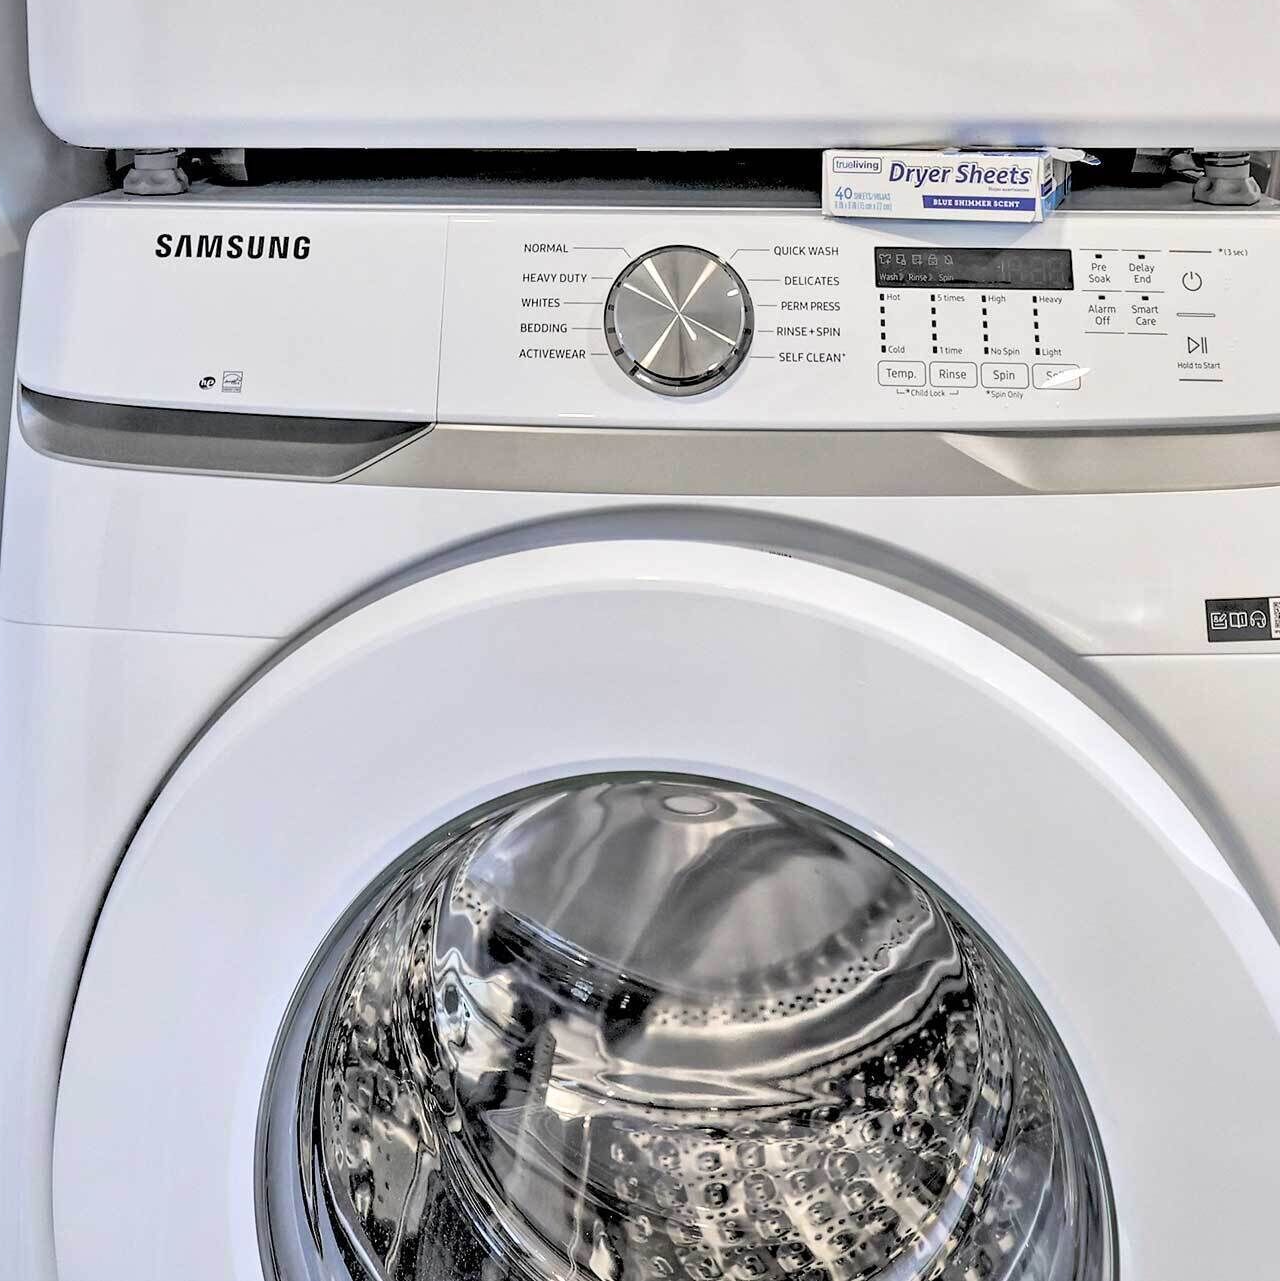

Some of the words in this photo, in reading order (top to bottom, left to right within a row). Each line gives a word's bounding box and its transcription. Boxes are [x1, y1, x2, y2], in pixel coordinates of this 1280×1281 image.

[889, 162, 950, 188] Dryer
[956, 164, 1030, 184] Sheets
[834, 186, 852, 200] 40
[933, 199, 952, 207] BLUE
[955, 199, 992, 208] SHIMMER
[994, 200, 1020, 208] SCENT
[154, 233, 311, 260] SAMSUNG
[523, 243, 569, 253] NORMAL
[773, 245, 806, 256] QUICK
[807, 246, 839, 256] WASH
[1091, 262, 1107, 272] Pre
[1128, 262, 1155, 275] Delay
[522, 273, 557, 283] HEAVY
[559, 273, 588, 283] DUTY
[784, 275, 840, 286] DELICATES
[880, 273, 898, 281] Wash
[1088, 273, 1111, 284] Soak
[1134, 274, 1151, 283] End
[886, 293, 901, 301] Hot
[936, 293, 943, 302] 5
[943, 294, 966, 302] times
[987, 295, 1006, 305] High
[1038, 295, 1063, 305] Heavy
[521, 297, 561, 308] WHITES
[781, 301, 809, 311] PERM
[810, 301, 841, 312] PRESS
[1088, 304, 1117, 314] Alarm
[1130, 304, 1159, 314] Smart
[1095, 315, 1111, 326] Off
[1135, 316, 1157, 326] Care
[520, 322, 568, 334] BEDDING
[518, 348, 586, 359] ACTIVEWEAR
[887, 345, 906, 354] Cold
[939, 346, 944, 354] 1
[944, 347, 963, 355] time
[990, 347, 1002, 356] No
[1002, 346, 1021, 357] Spin
[1041, 348, 1062, 358] Light
[778, 352, 804, 363] SELF
[1177, 361, 1194, 370] Hold
[1194, 362, 1203, 370] to
[1202, 361, 1221, 370] Start
[885, 367, 917, 380] Temp.
[939, 368, 967, 380] Rinse
[992, 369, 1016, 382] Spin
[929, 389, 945, 398] Lock
[1008, 390, 1024, 399] Only
